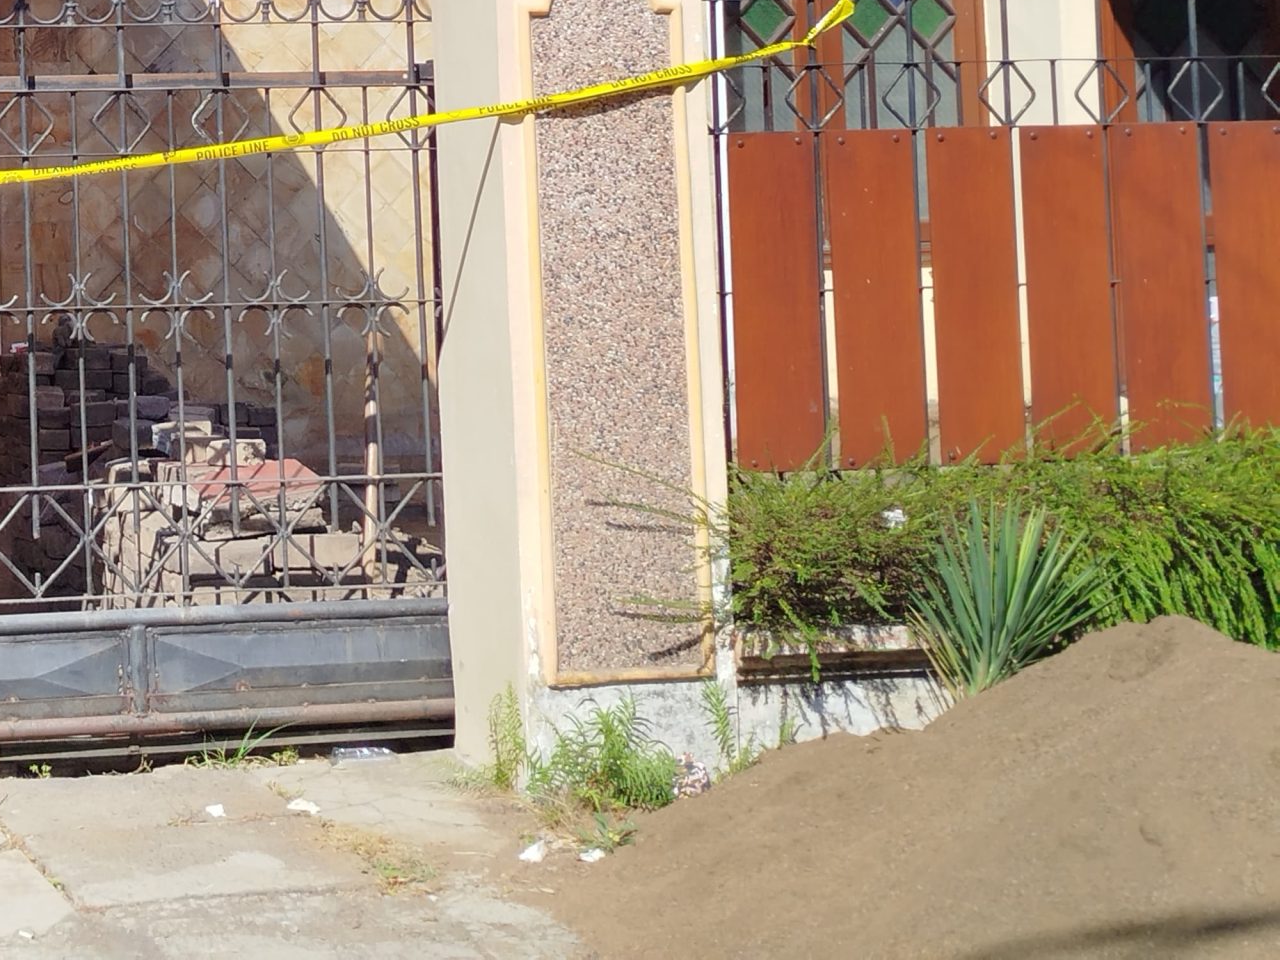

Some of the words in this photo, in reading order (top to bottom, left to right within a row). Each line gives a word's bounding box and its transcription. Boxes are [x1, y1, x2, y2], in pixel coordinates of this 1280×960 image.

[331, 130, 349, 143] DO
[351, 124, 376, 138] NOT
[379, 115, 420, 133] CROSS
[195, 144, 239, 161] POLICE
[241, 139, 270, 155] LINE
